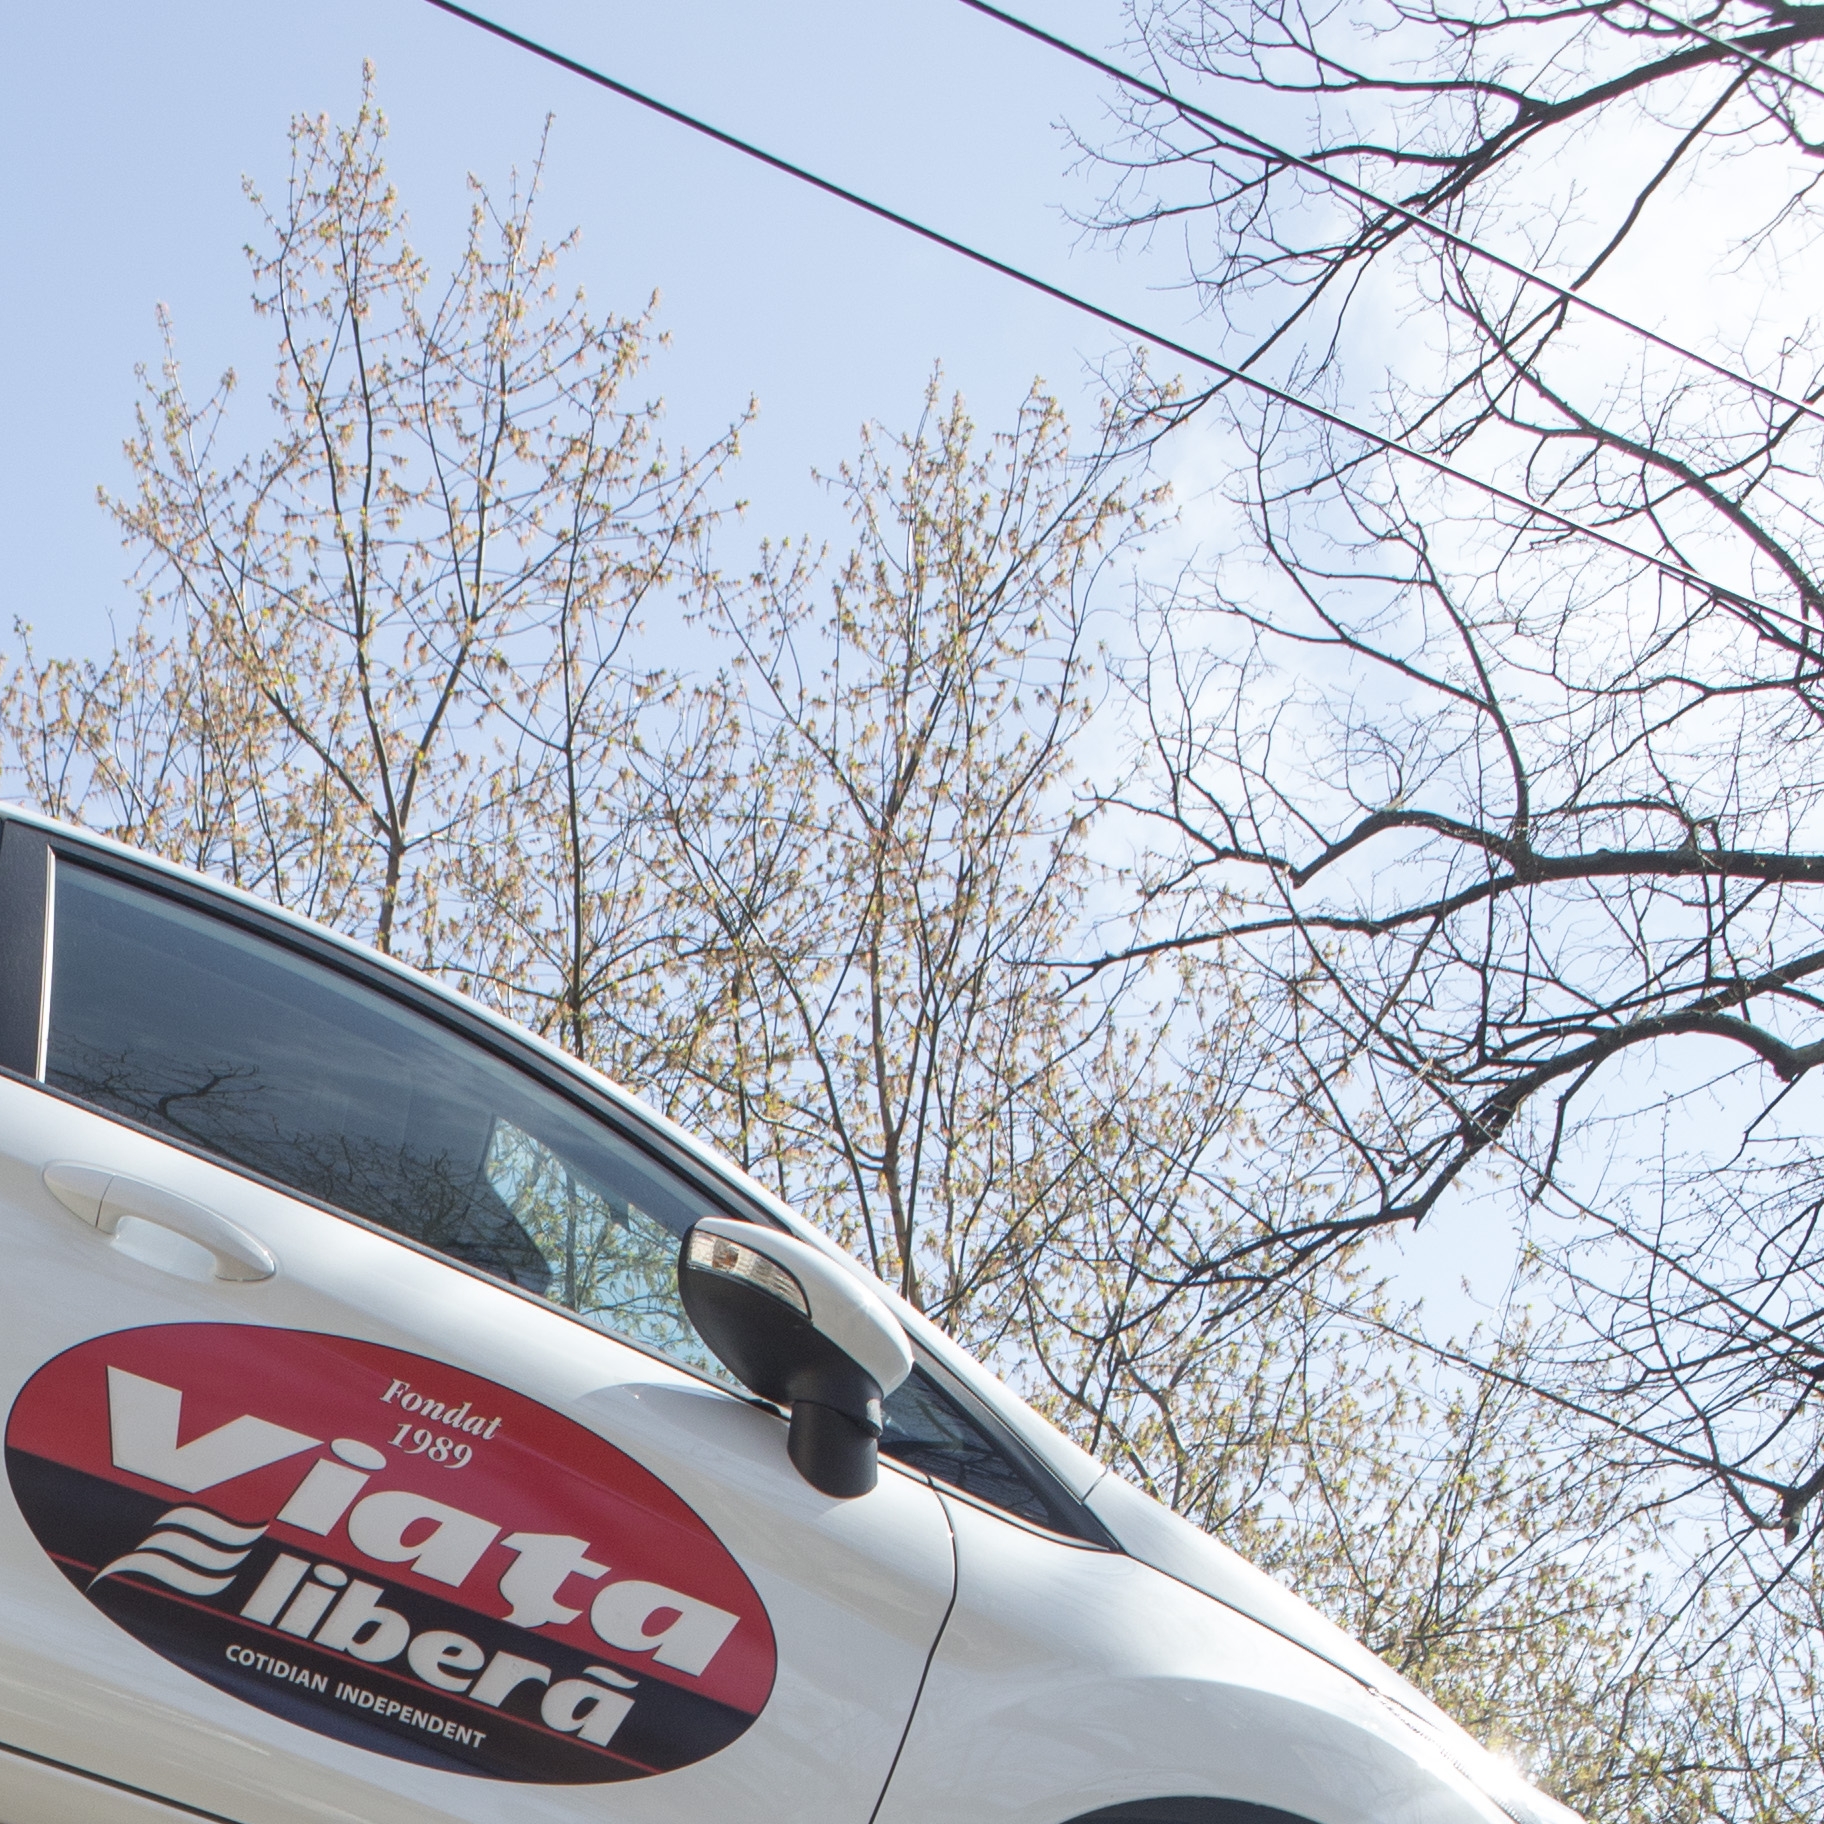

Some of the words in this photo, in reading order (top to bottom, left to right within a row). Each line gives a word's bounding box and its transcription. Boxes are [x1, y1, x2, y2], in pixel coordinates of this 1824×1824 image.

[379, 1378, 504, 1442] Fondat
[386, 1421, 475, 1470] 1989
[225, 1643, 329, 1695] COTIDIAN
[334, 1682, 487, 1749] INDEPENDENT
